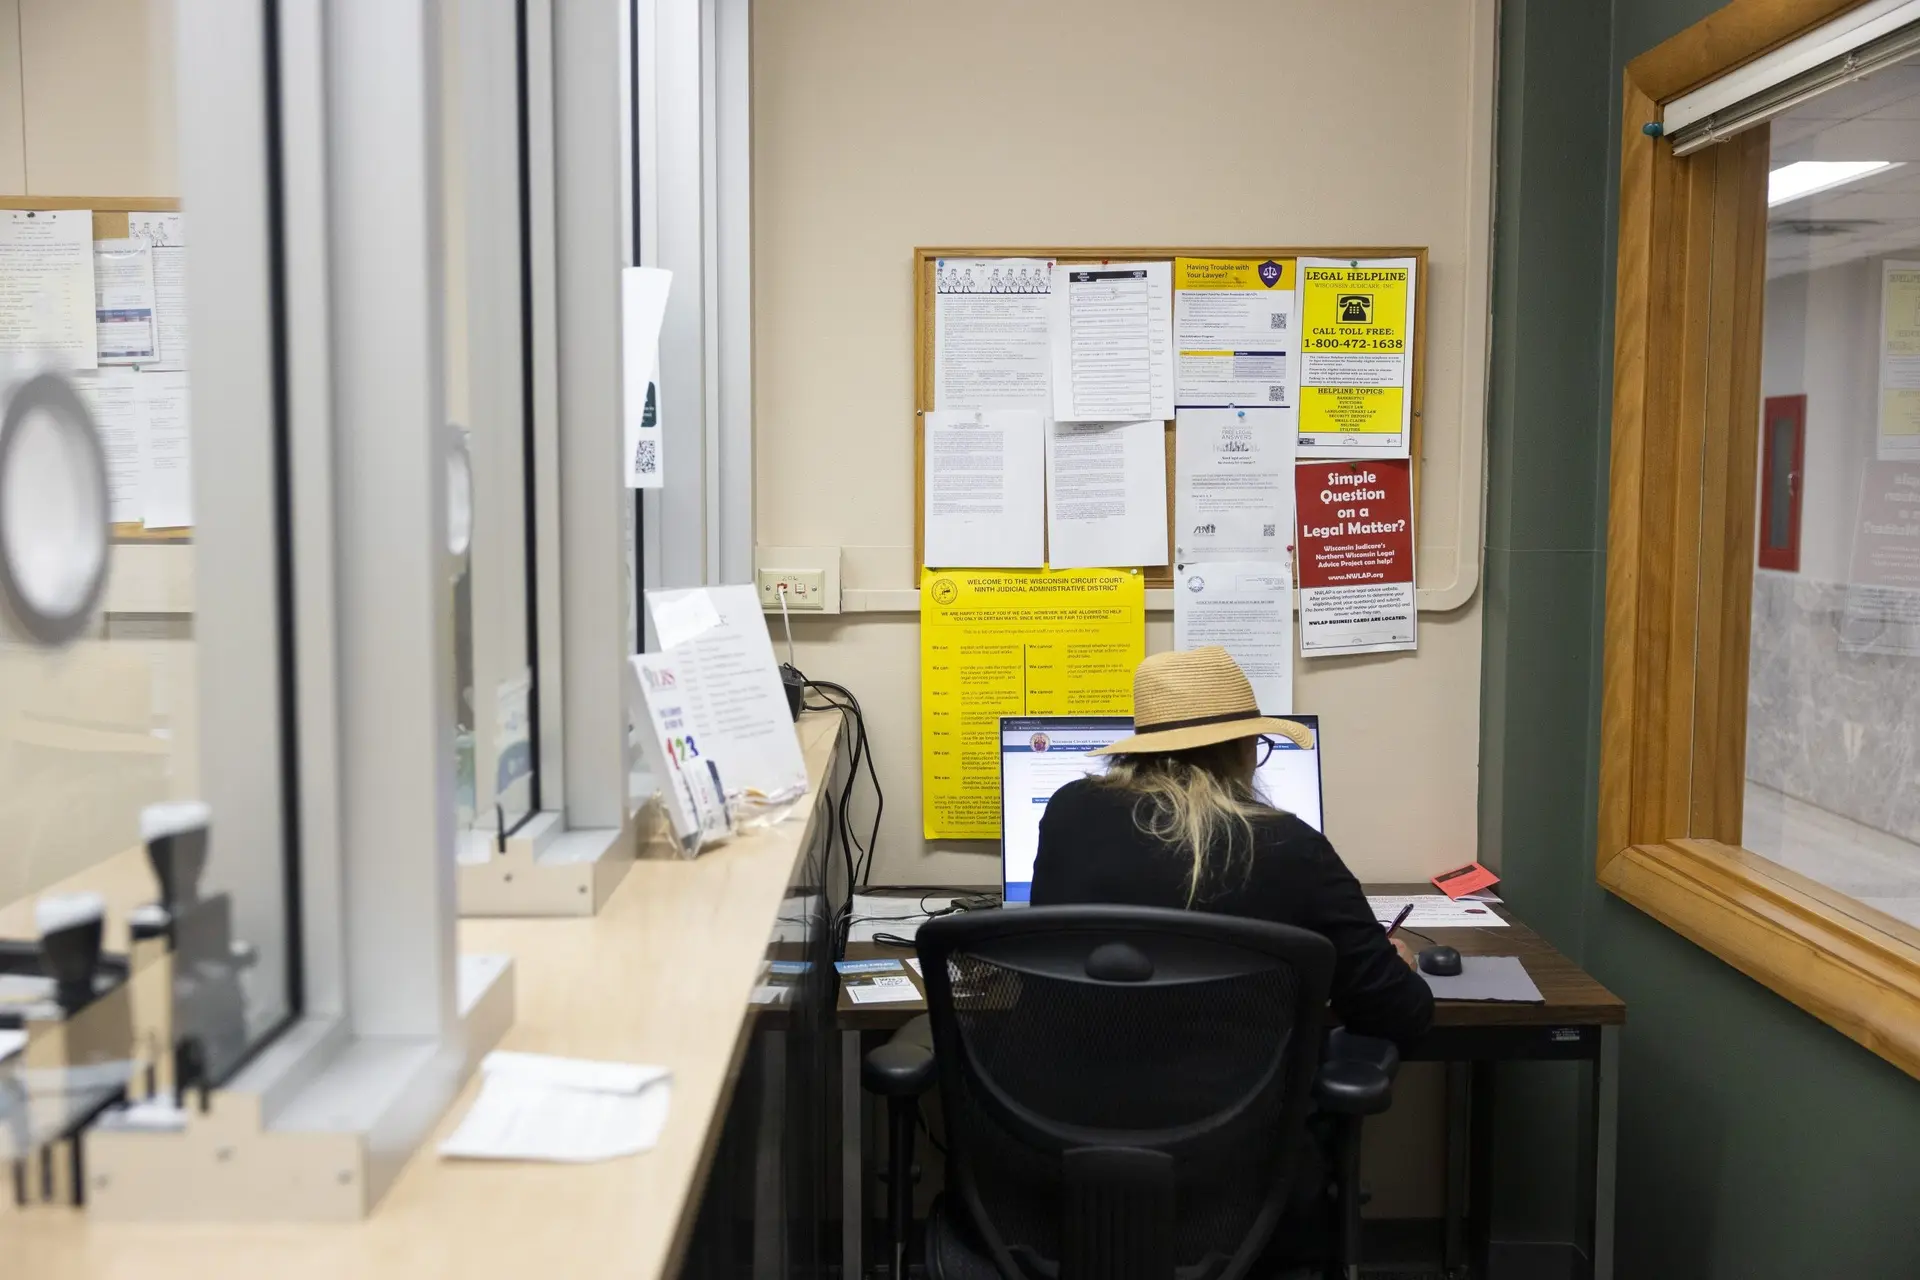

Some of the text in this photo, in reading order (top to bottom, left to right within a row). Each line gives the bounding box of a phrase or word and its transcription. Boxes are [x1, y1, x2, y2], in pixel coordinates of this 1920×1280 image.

[1306, 272, 1406, 281] LEGAL HELPLINE
[1305, 339, 1403, 348] 1-800-472-1638
[1328, 471, 1376, 486] Simple
[1320, 488, 1385, 504] Question
[1337, 508, 1369, 518] on a
[1304, 519, 1405, 538] Legal Matter?
[1328, 572, 1384, 581] www.NWLAP.org
